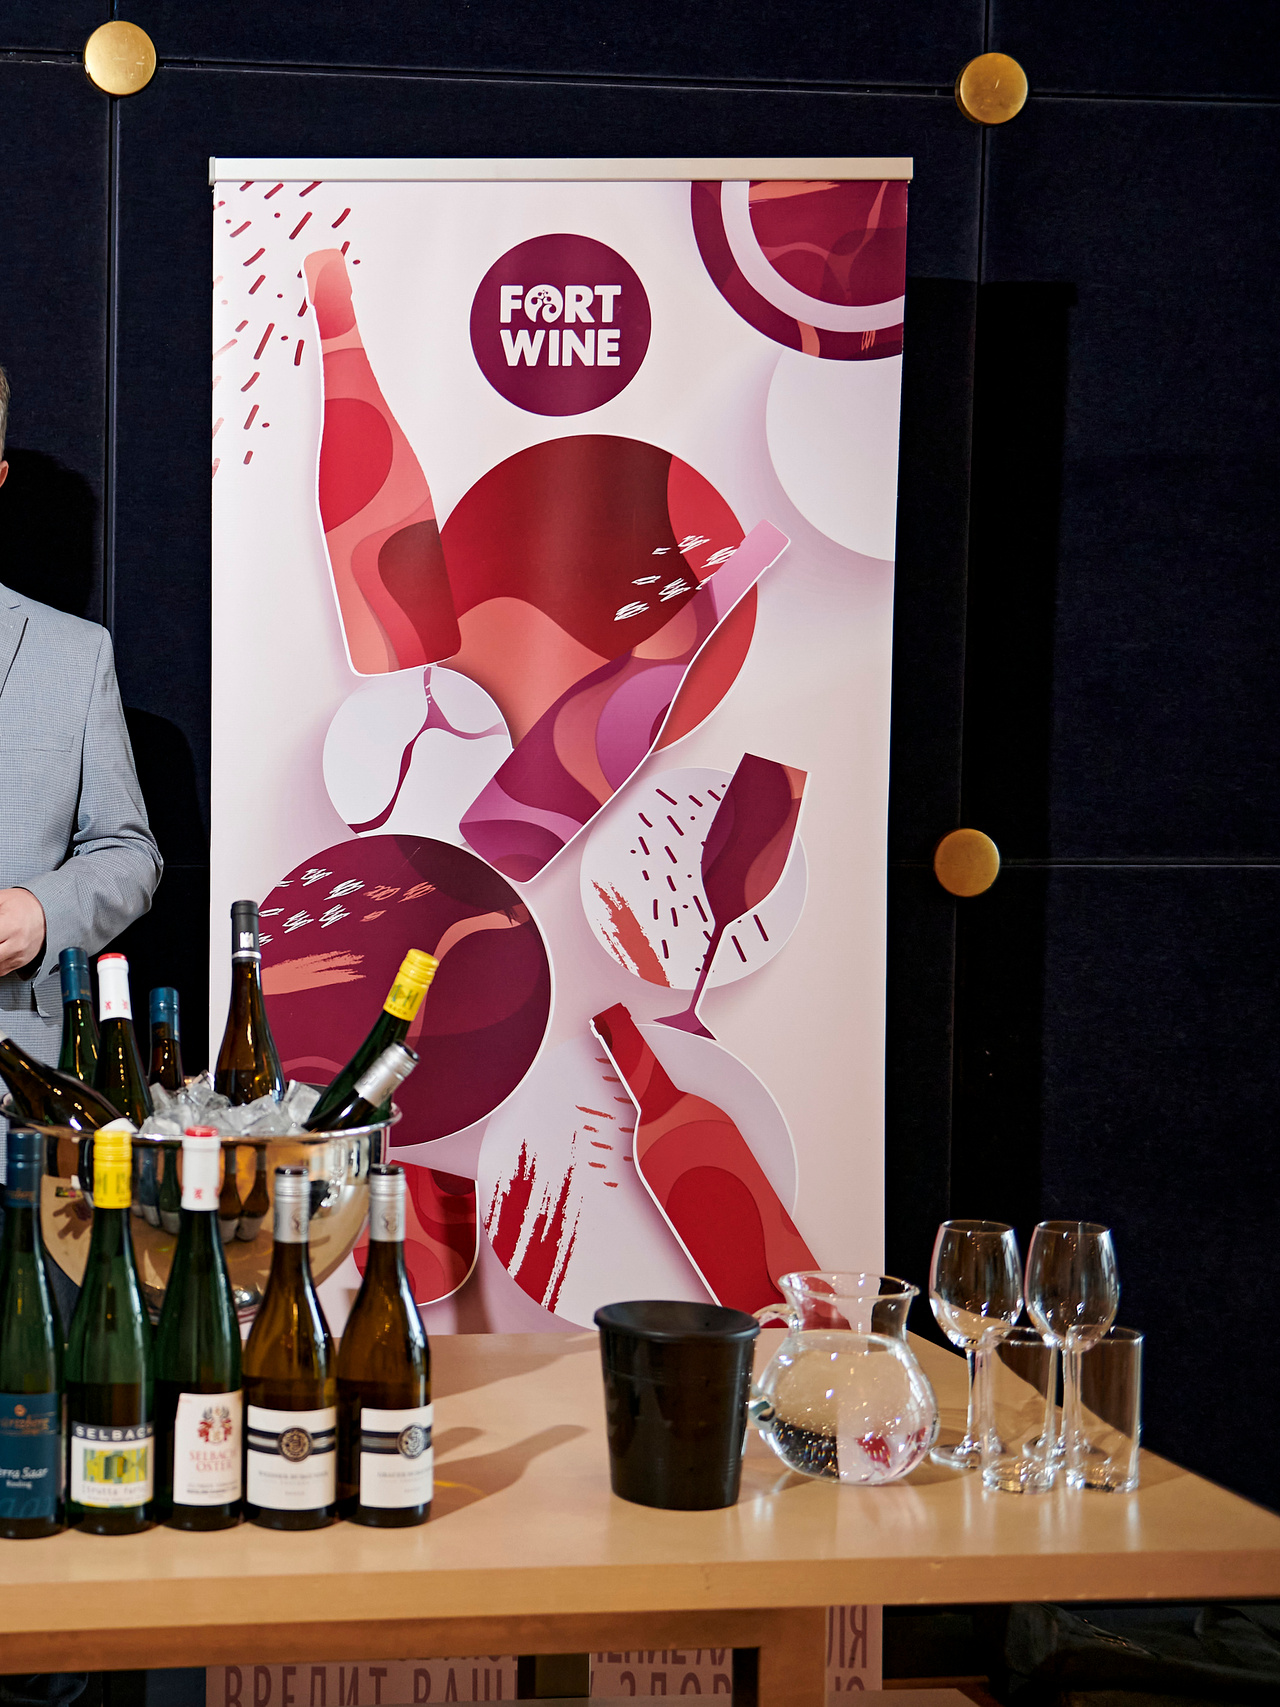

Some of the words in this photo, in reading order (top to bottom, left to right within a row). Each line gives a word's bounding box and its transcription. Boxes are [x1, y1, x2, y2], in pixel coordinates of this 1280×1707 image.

[499, 284, 622, 324] FORT
[499, 329, 621, 367] WINE
[21, 1466, 49, 1479] Saar
